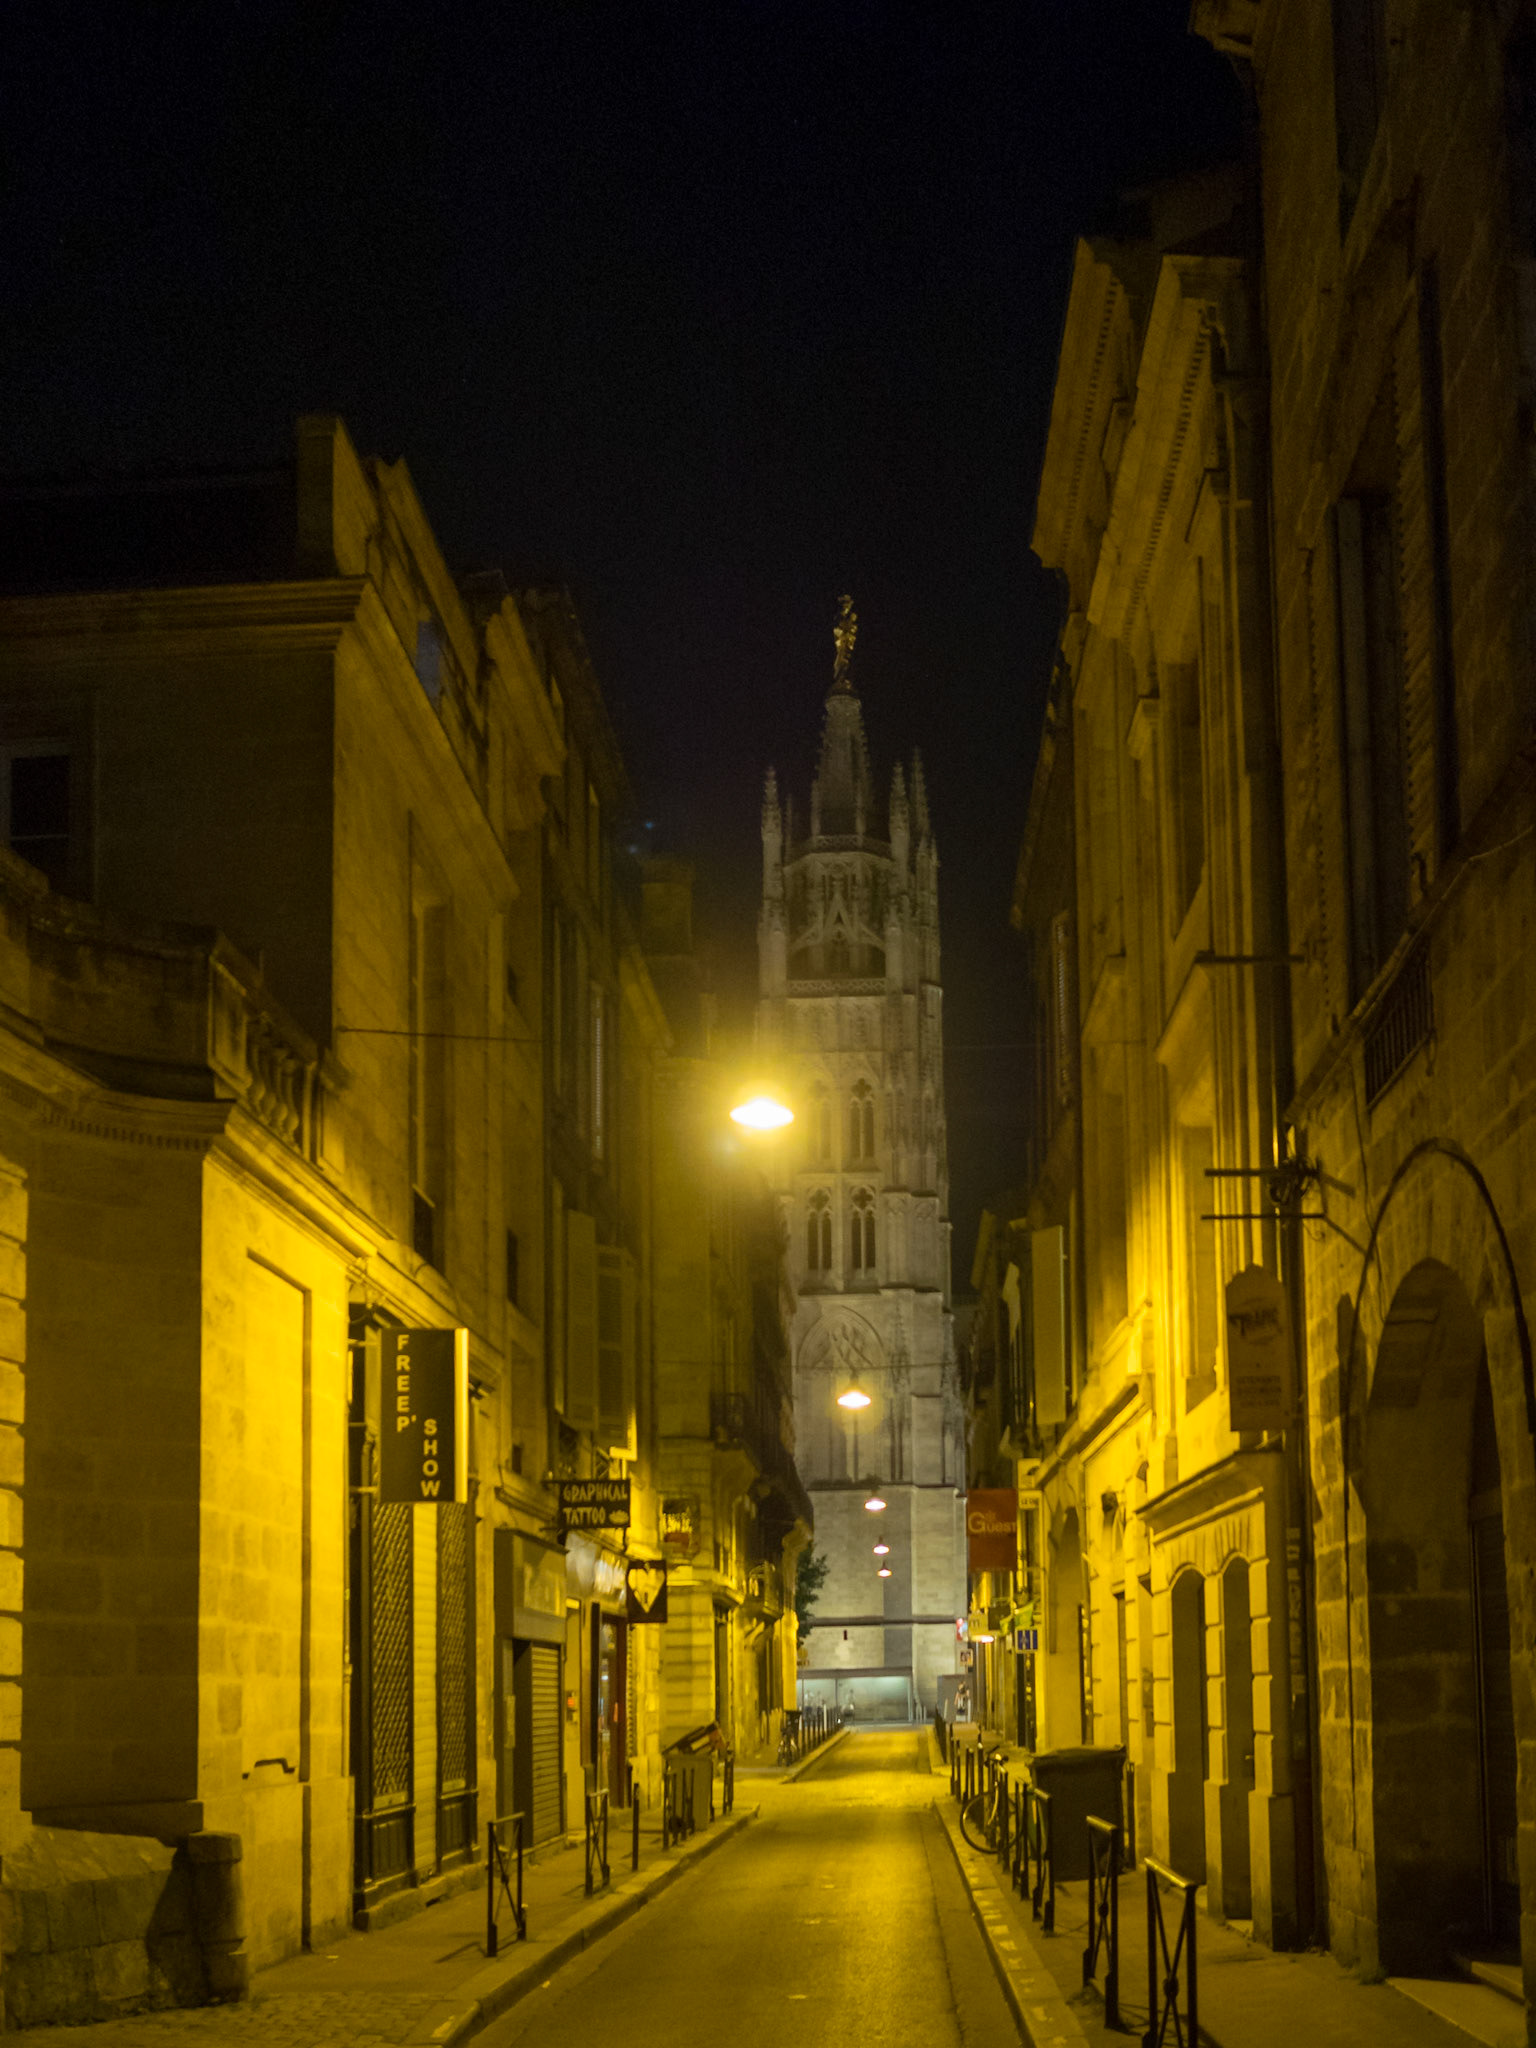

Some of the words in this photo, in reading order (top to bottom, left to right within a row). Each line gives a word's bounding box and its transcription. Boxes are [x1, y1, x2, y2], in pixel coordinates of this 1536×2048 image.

[420, 1418, 440, 1497] SHOW
[563, 1482, 628, 1502] GRAPHICAL
[562, 1506, 605, 1525] TATTOO
